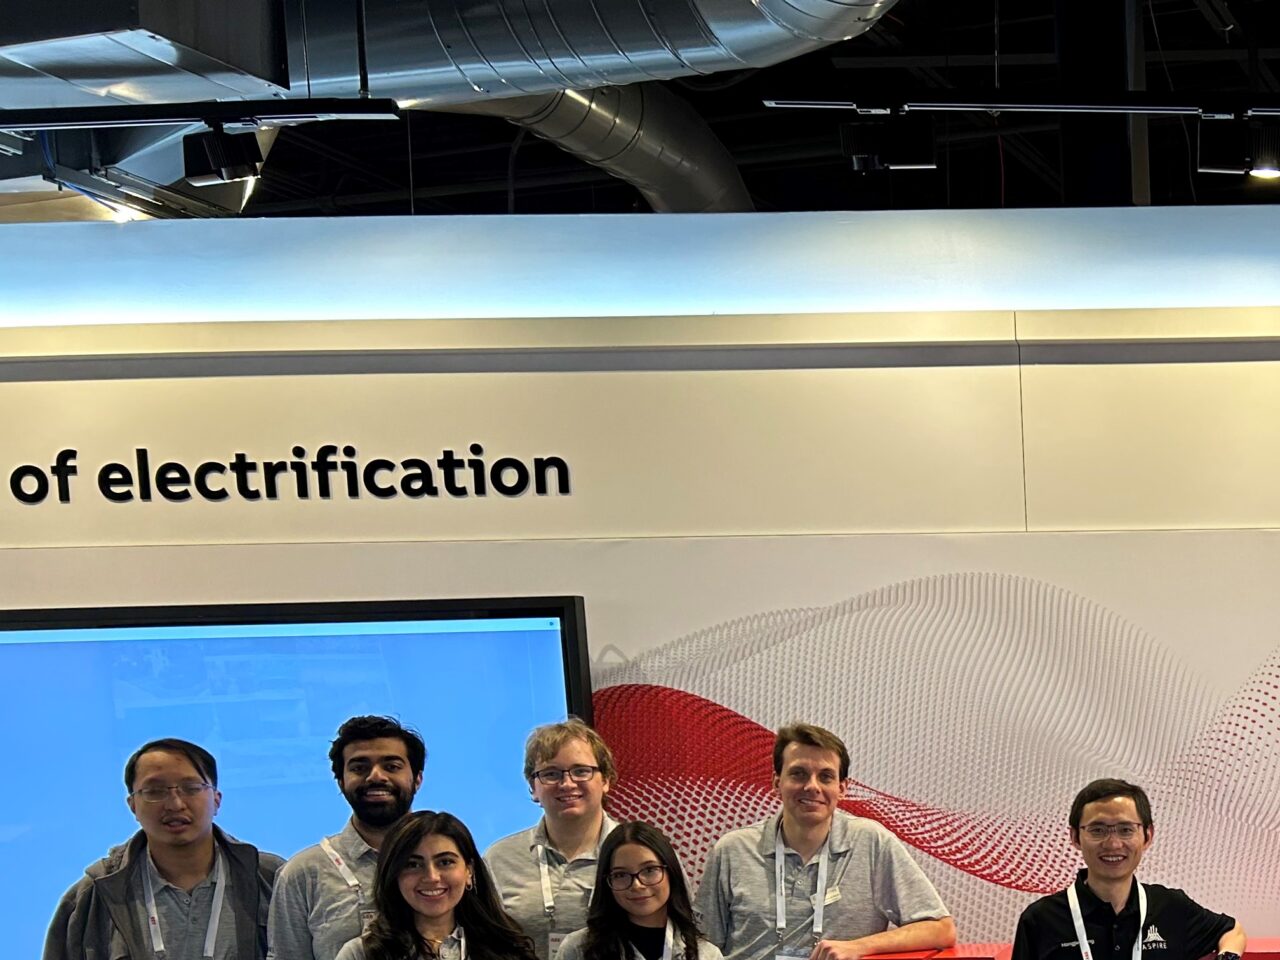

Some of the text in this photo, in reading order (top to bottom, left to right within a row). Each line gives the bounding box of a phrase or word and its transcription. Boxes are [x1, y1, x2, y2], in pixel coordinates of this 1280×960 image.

[10, 443, 572, 503] of electrification
[1142, 942, 1167, 950] ASPIRE
